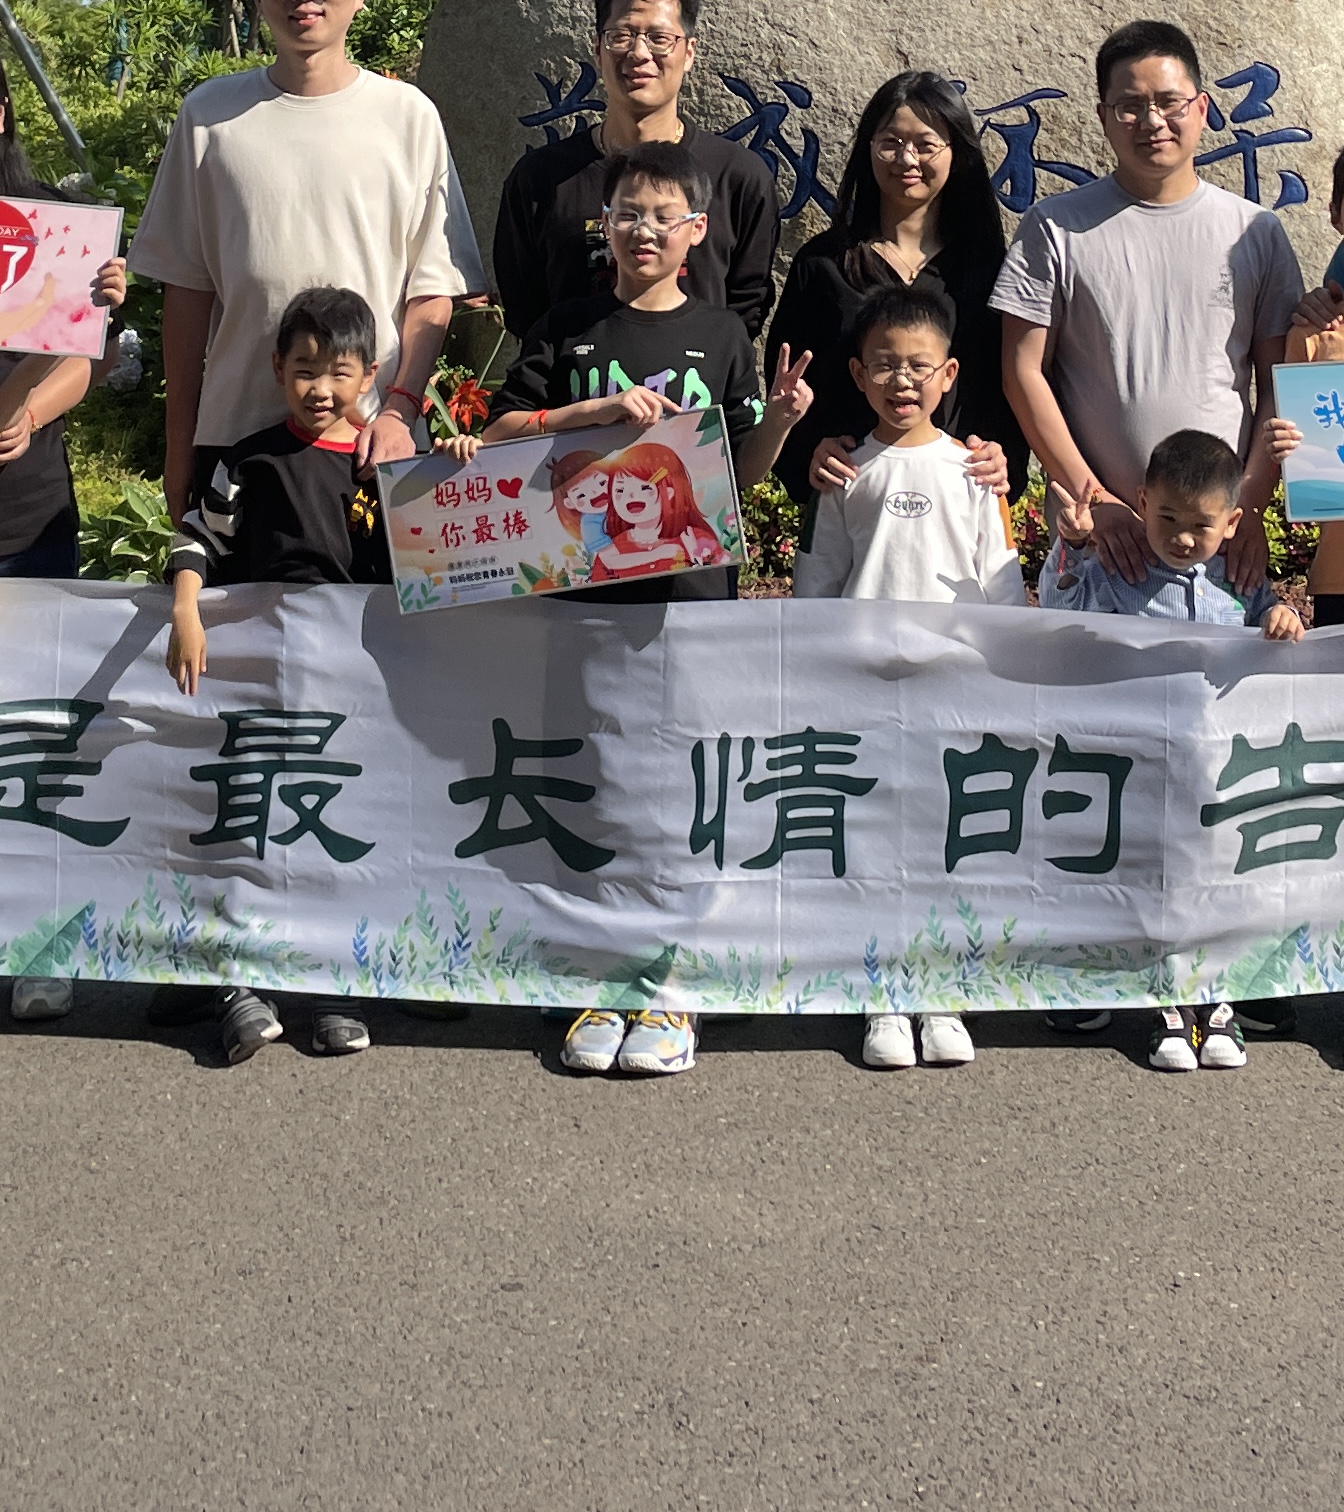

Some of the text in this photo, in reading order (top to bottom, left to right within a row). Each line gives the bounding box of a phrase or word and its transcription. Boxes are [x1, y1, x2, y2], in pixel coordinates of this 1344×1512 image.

[434, 476, 493, 509] 妈妈
[439, 510, 531, 549] 你最棒
